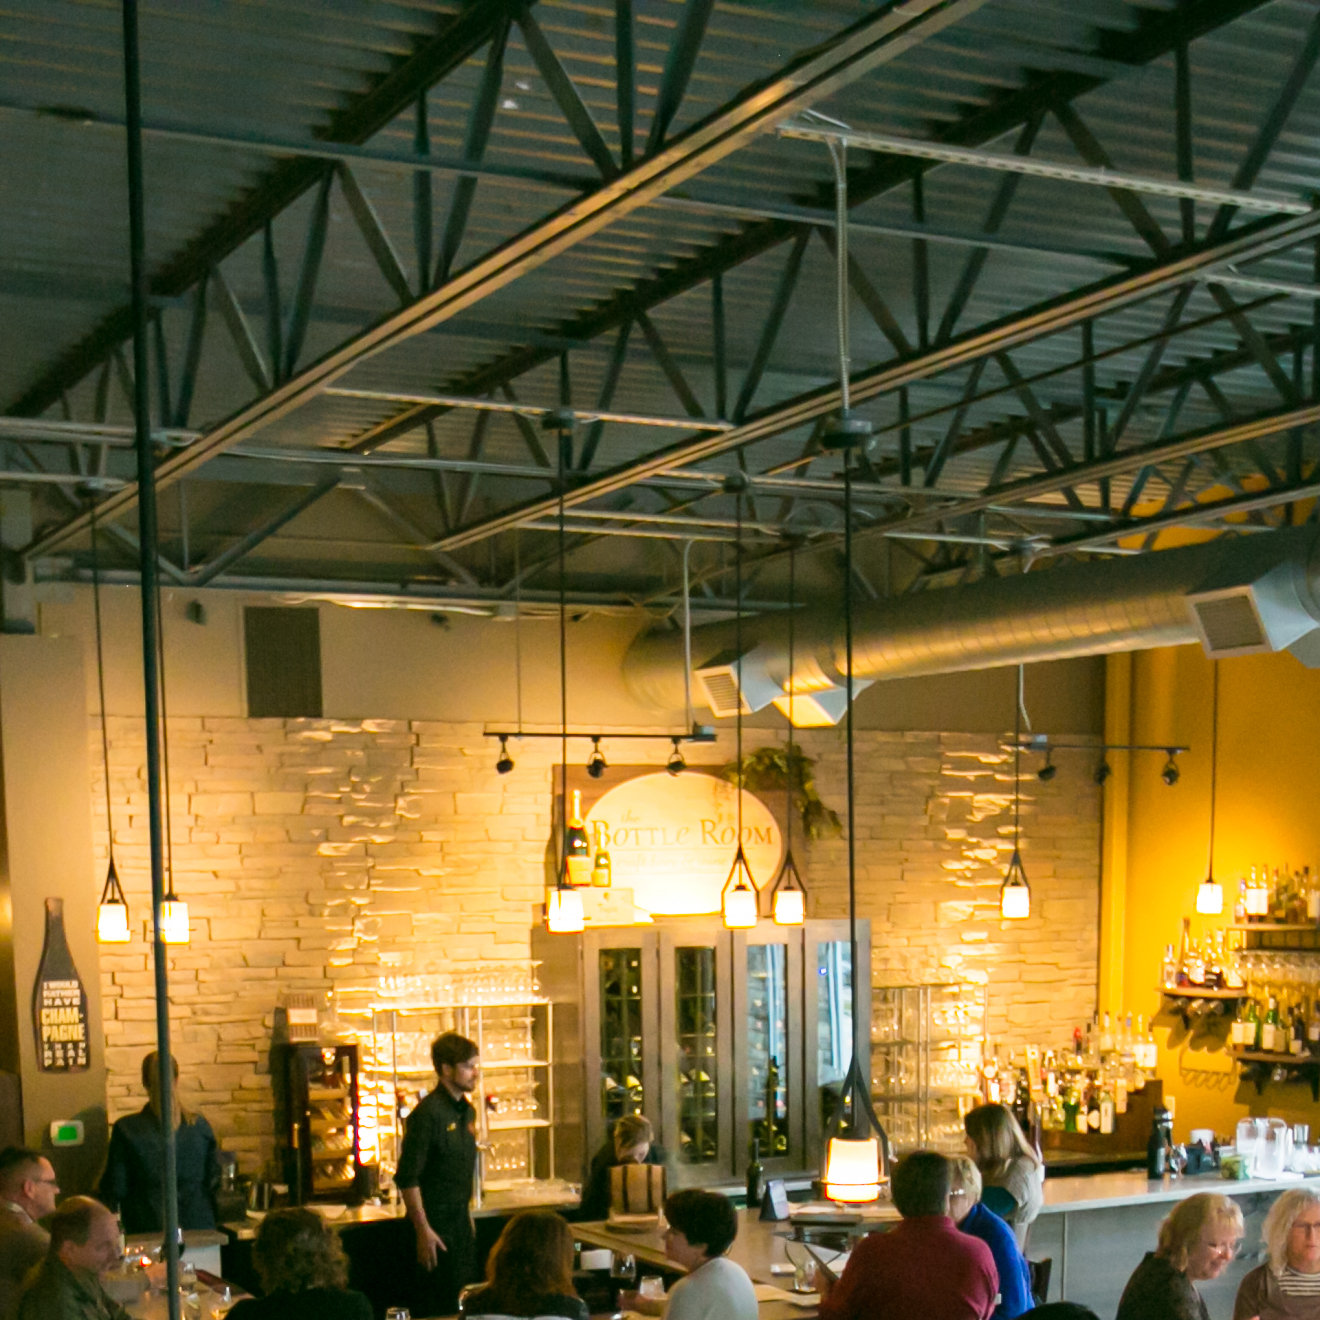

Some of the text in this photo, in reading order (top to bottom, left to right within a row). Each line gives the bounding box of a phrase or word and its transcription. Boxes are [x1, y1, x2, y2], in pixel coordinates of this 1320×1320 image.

[699, 818, 774, 846] ROOM
[43, 998, 81, 1007] HAVE
[41, 1007, 84, 1026] CHAM-
[42, 1023, 86, 1042] PAGNE
